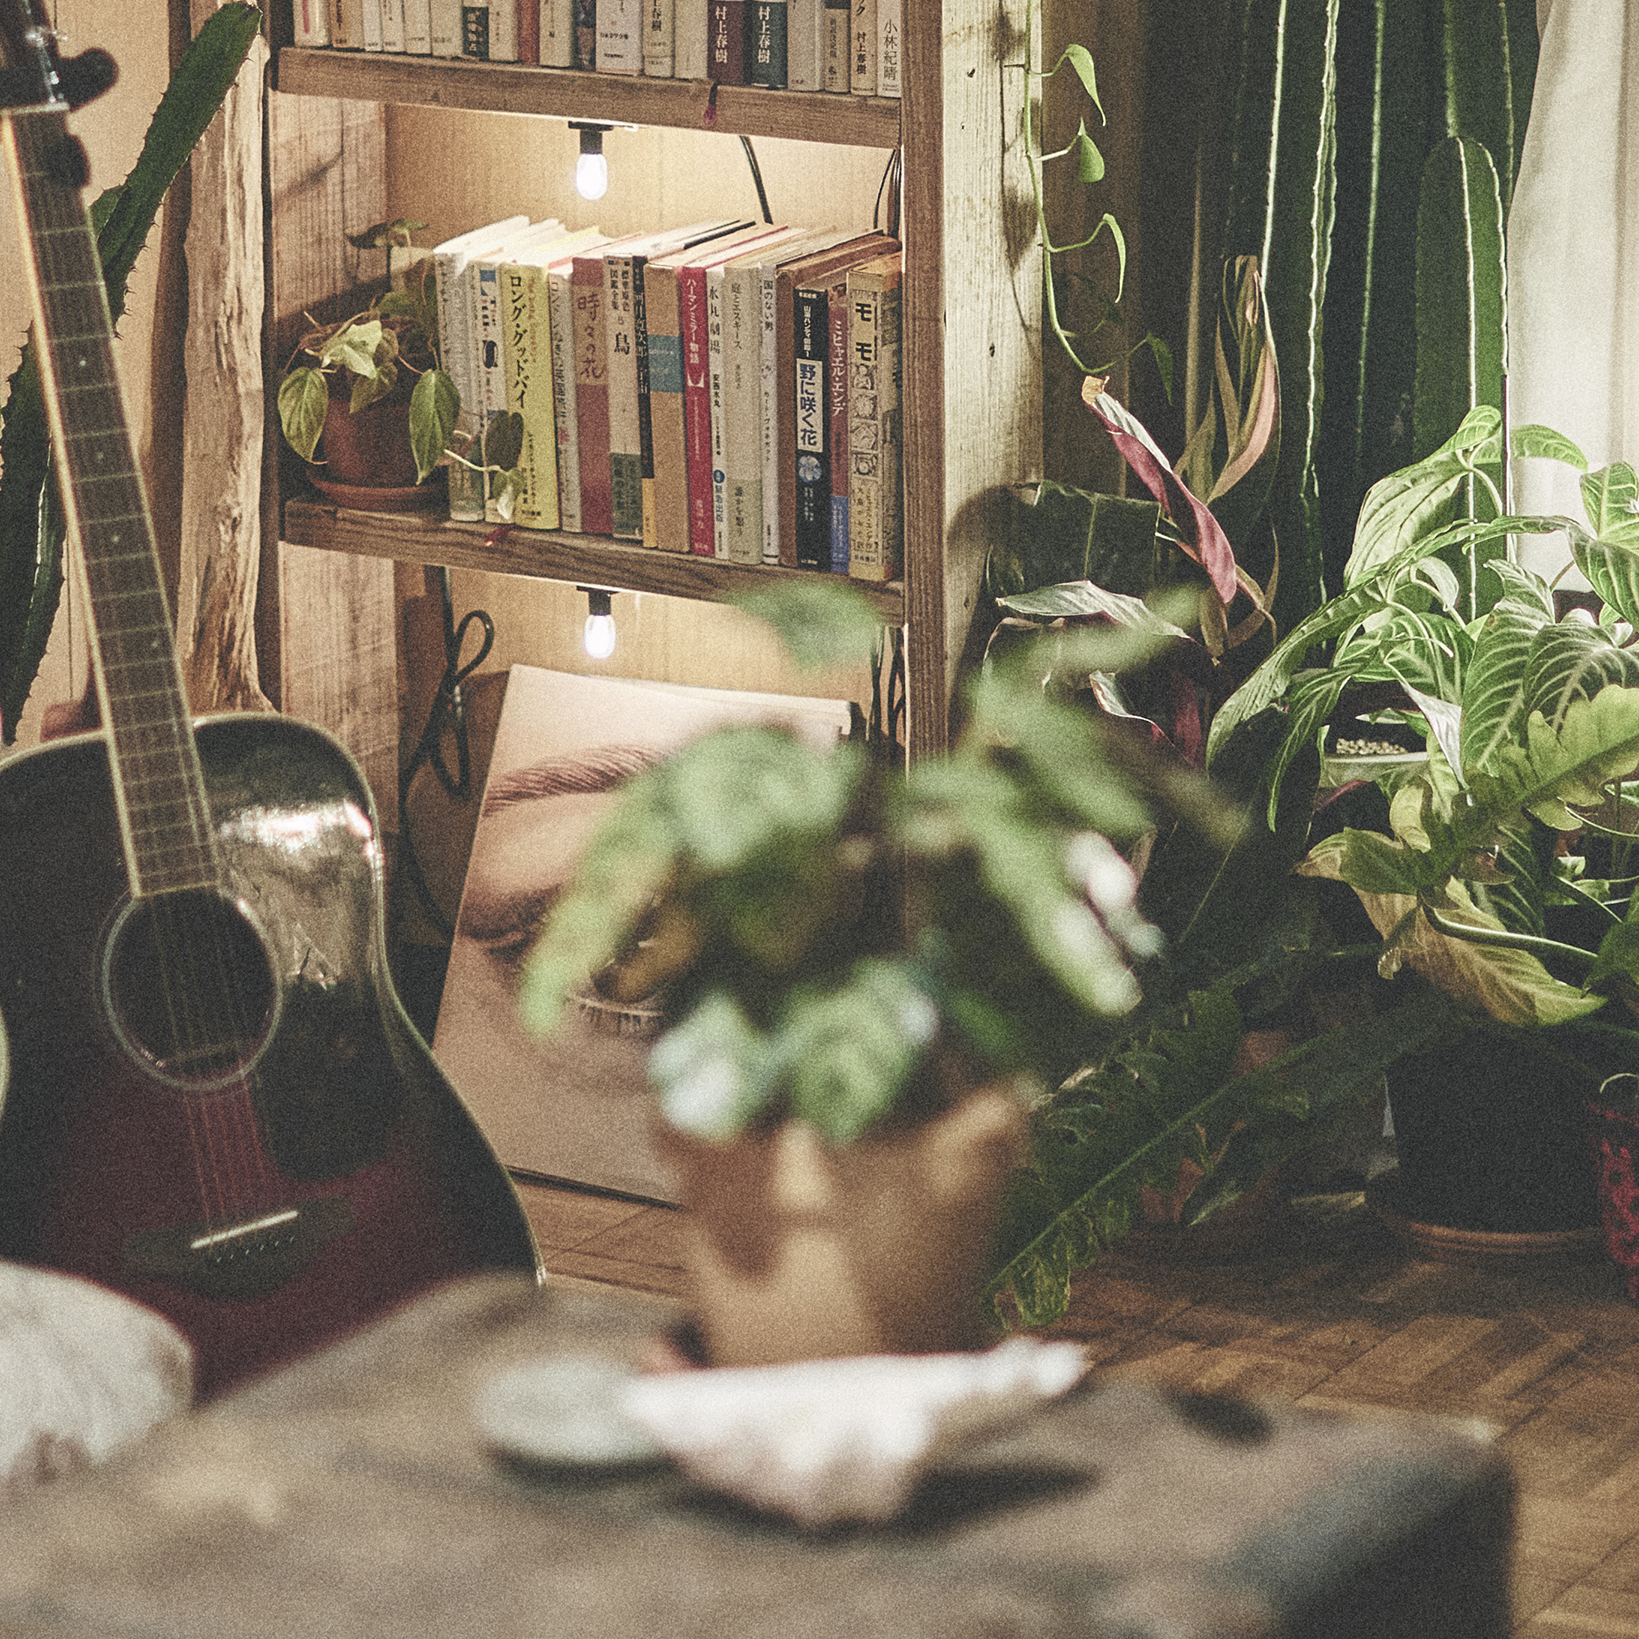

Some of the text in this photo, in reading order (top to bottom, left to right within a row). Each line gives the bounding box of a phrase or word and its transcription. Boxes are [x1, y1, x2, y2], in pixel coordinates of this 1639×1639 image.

[715, 6, 728, 64] 村上春樹
[758, 6, 771, 64] 村上春樹
[856, 32, 867, 75] 村上春樹
[883, 19, 899, 81] 小林紀晴
[577, 291, 605, 379] 時々の花
[686, 278, 700, 365] ハーマンミラー物語
[709, 286, 721, 354] 水丸劇場
[731, 283, 742, 350] 庭とエスキース
[763, 280, 774, 332] 国のない男
[855, 302, 873, 362] モモ
[510, 275, 530, 409] ロング・グッドバイ
[614, 331, 631, 355] 鳥
[831, 319, 847, 417] ミヒャエル・エンデ
[800, 363, 818, 447] 野に咲く花
